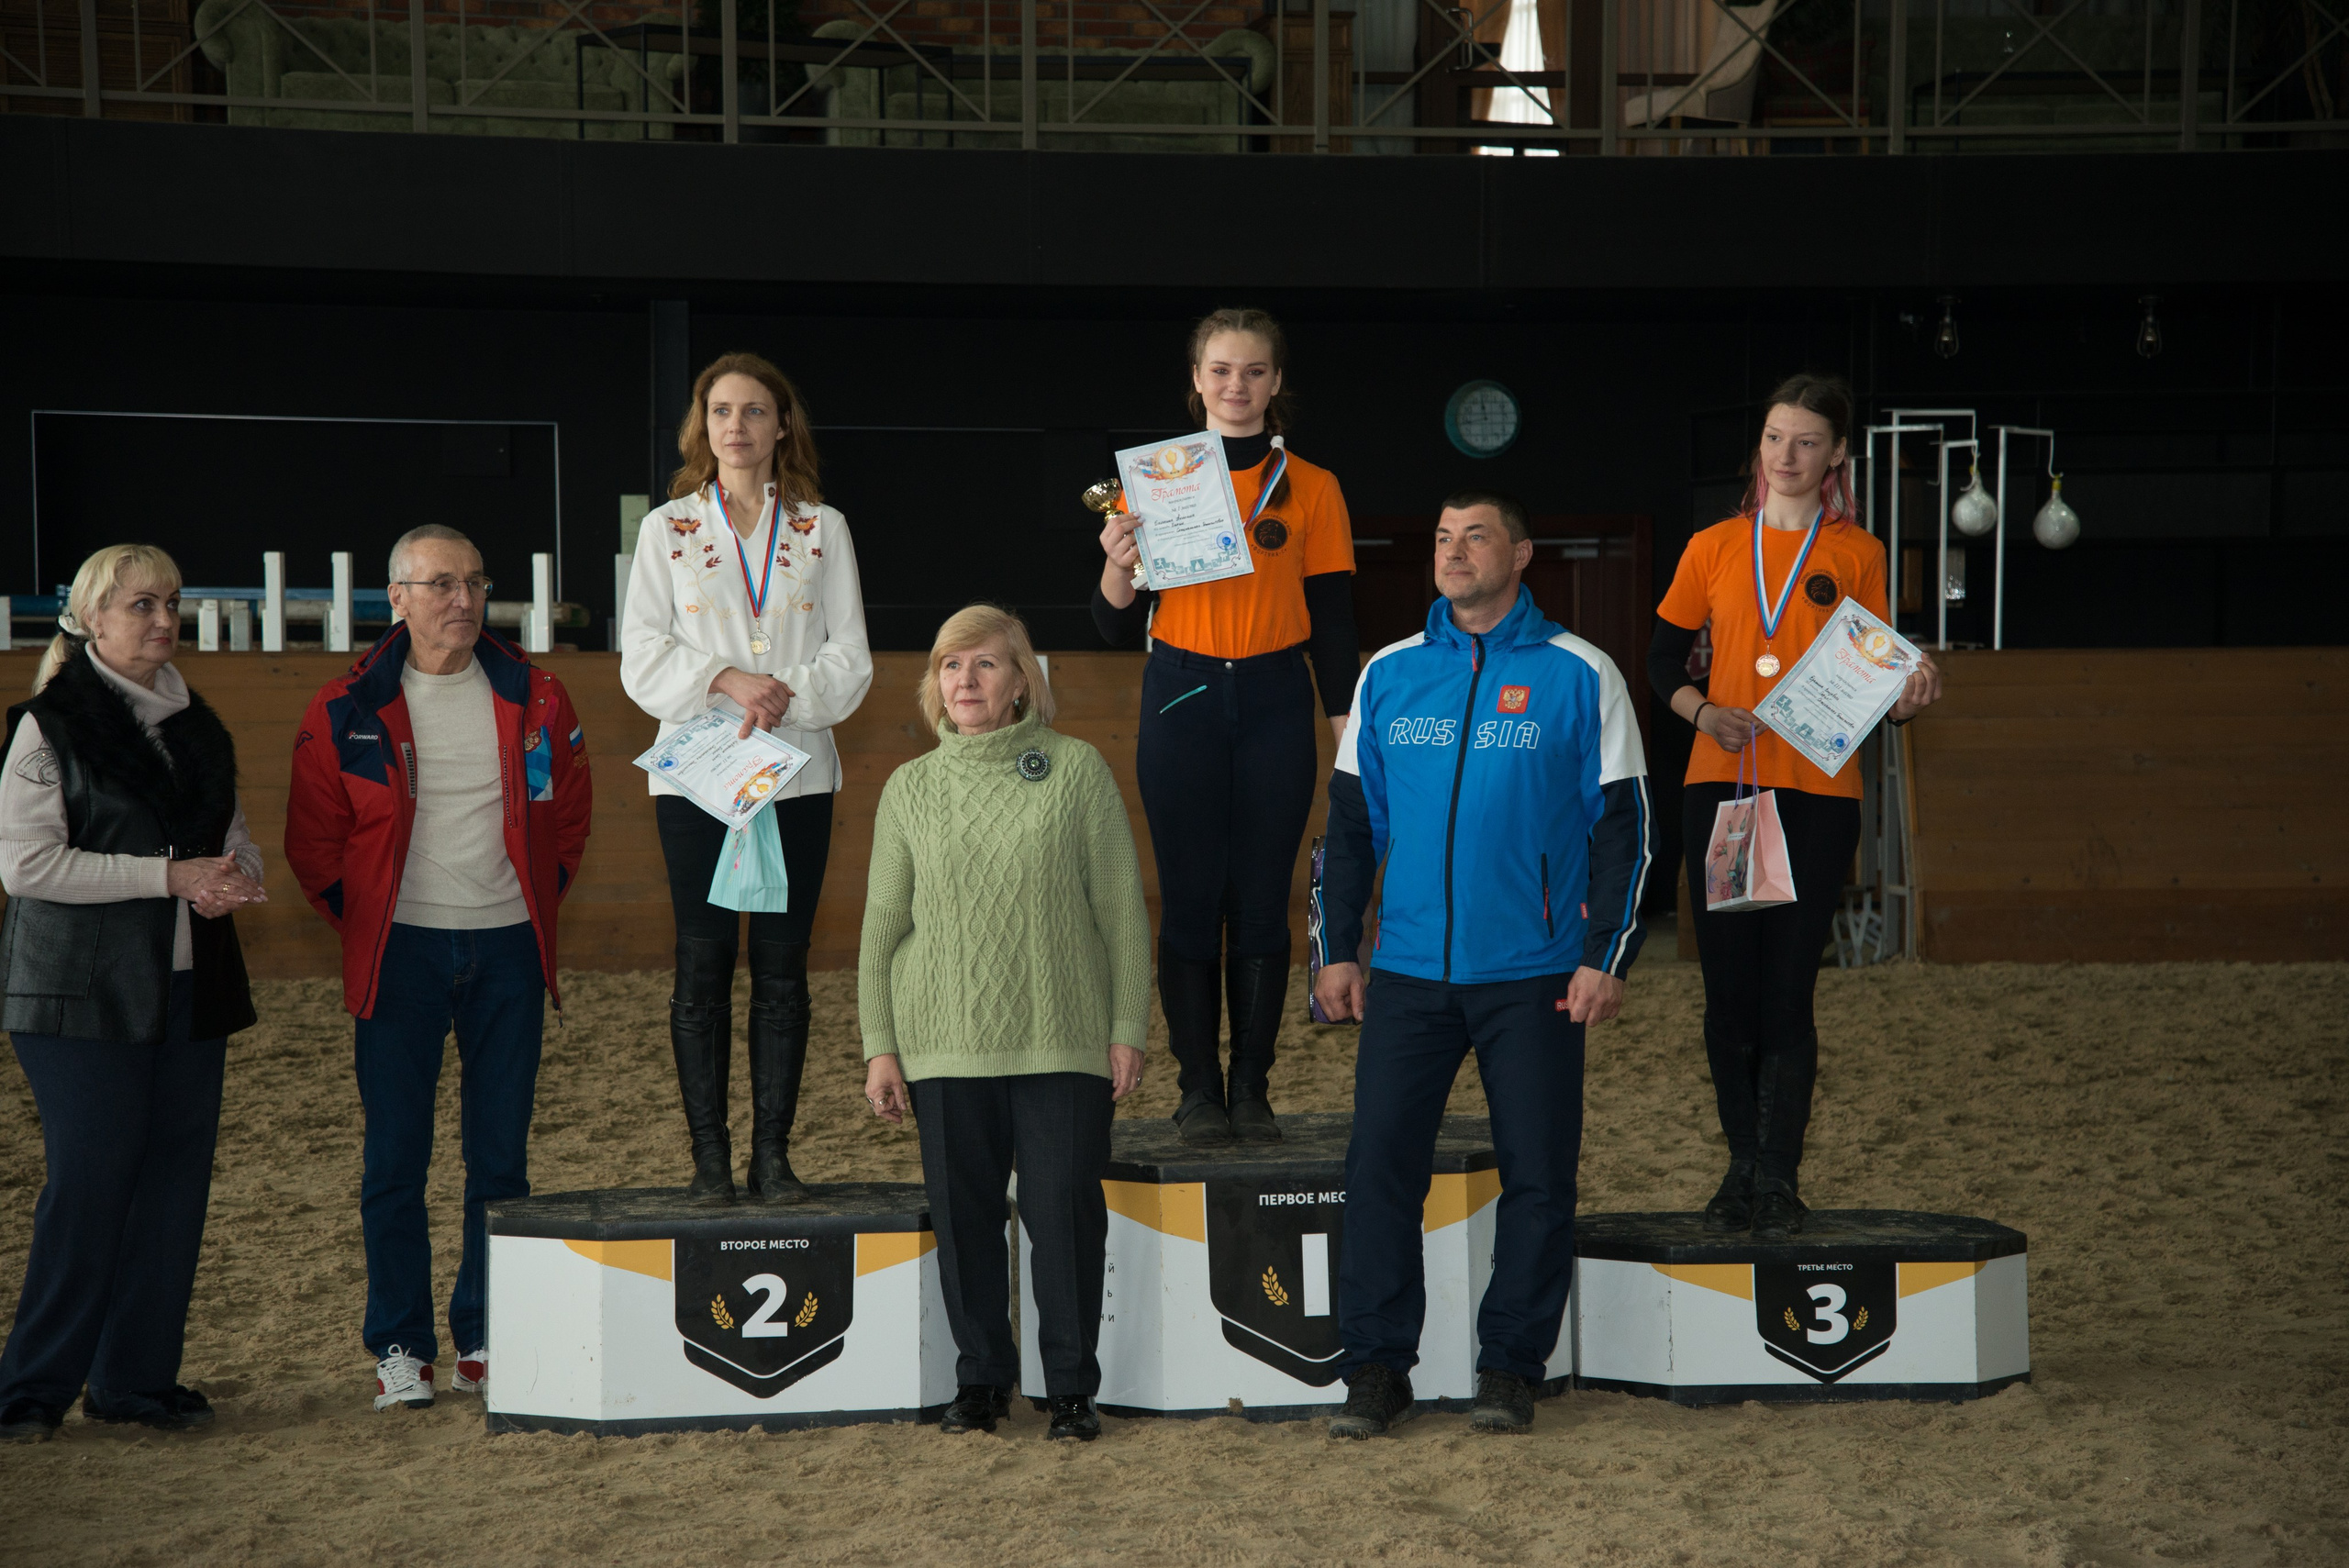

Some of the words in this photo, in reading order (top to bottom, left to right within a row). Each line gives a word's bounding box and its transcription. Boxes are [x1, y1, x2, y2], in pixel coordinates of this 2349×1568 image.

[1151, 483, 1201, 503] Грамота
[1834, 648, 1876, 684] Грамота
[349, 731, 379, 740] FORWARD
[723, 754, 763, 791] Грамота
[1259, 1193, 1315, 1206] ПЕРВОЕ
[720, 1240, 767, 1251] ВТОРОЕ
[769, 1239, 810, 1250] МЕСТО
[1798, 1263, 1825, 1272] ТРЕТЬЕ
[741, 1273, 788, 1339] 2
[1806, 1284, 1850, 1345] 3
